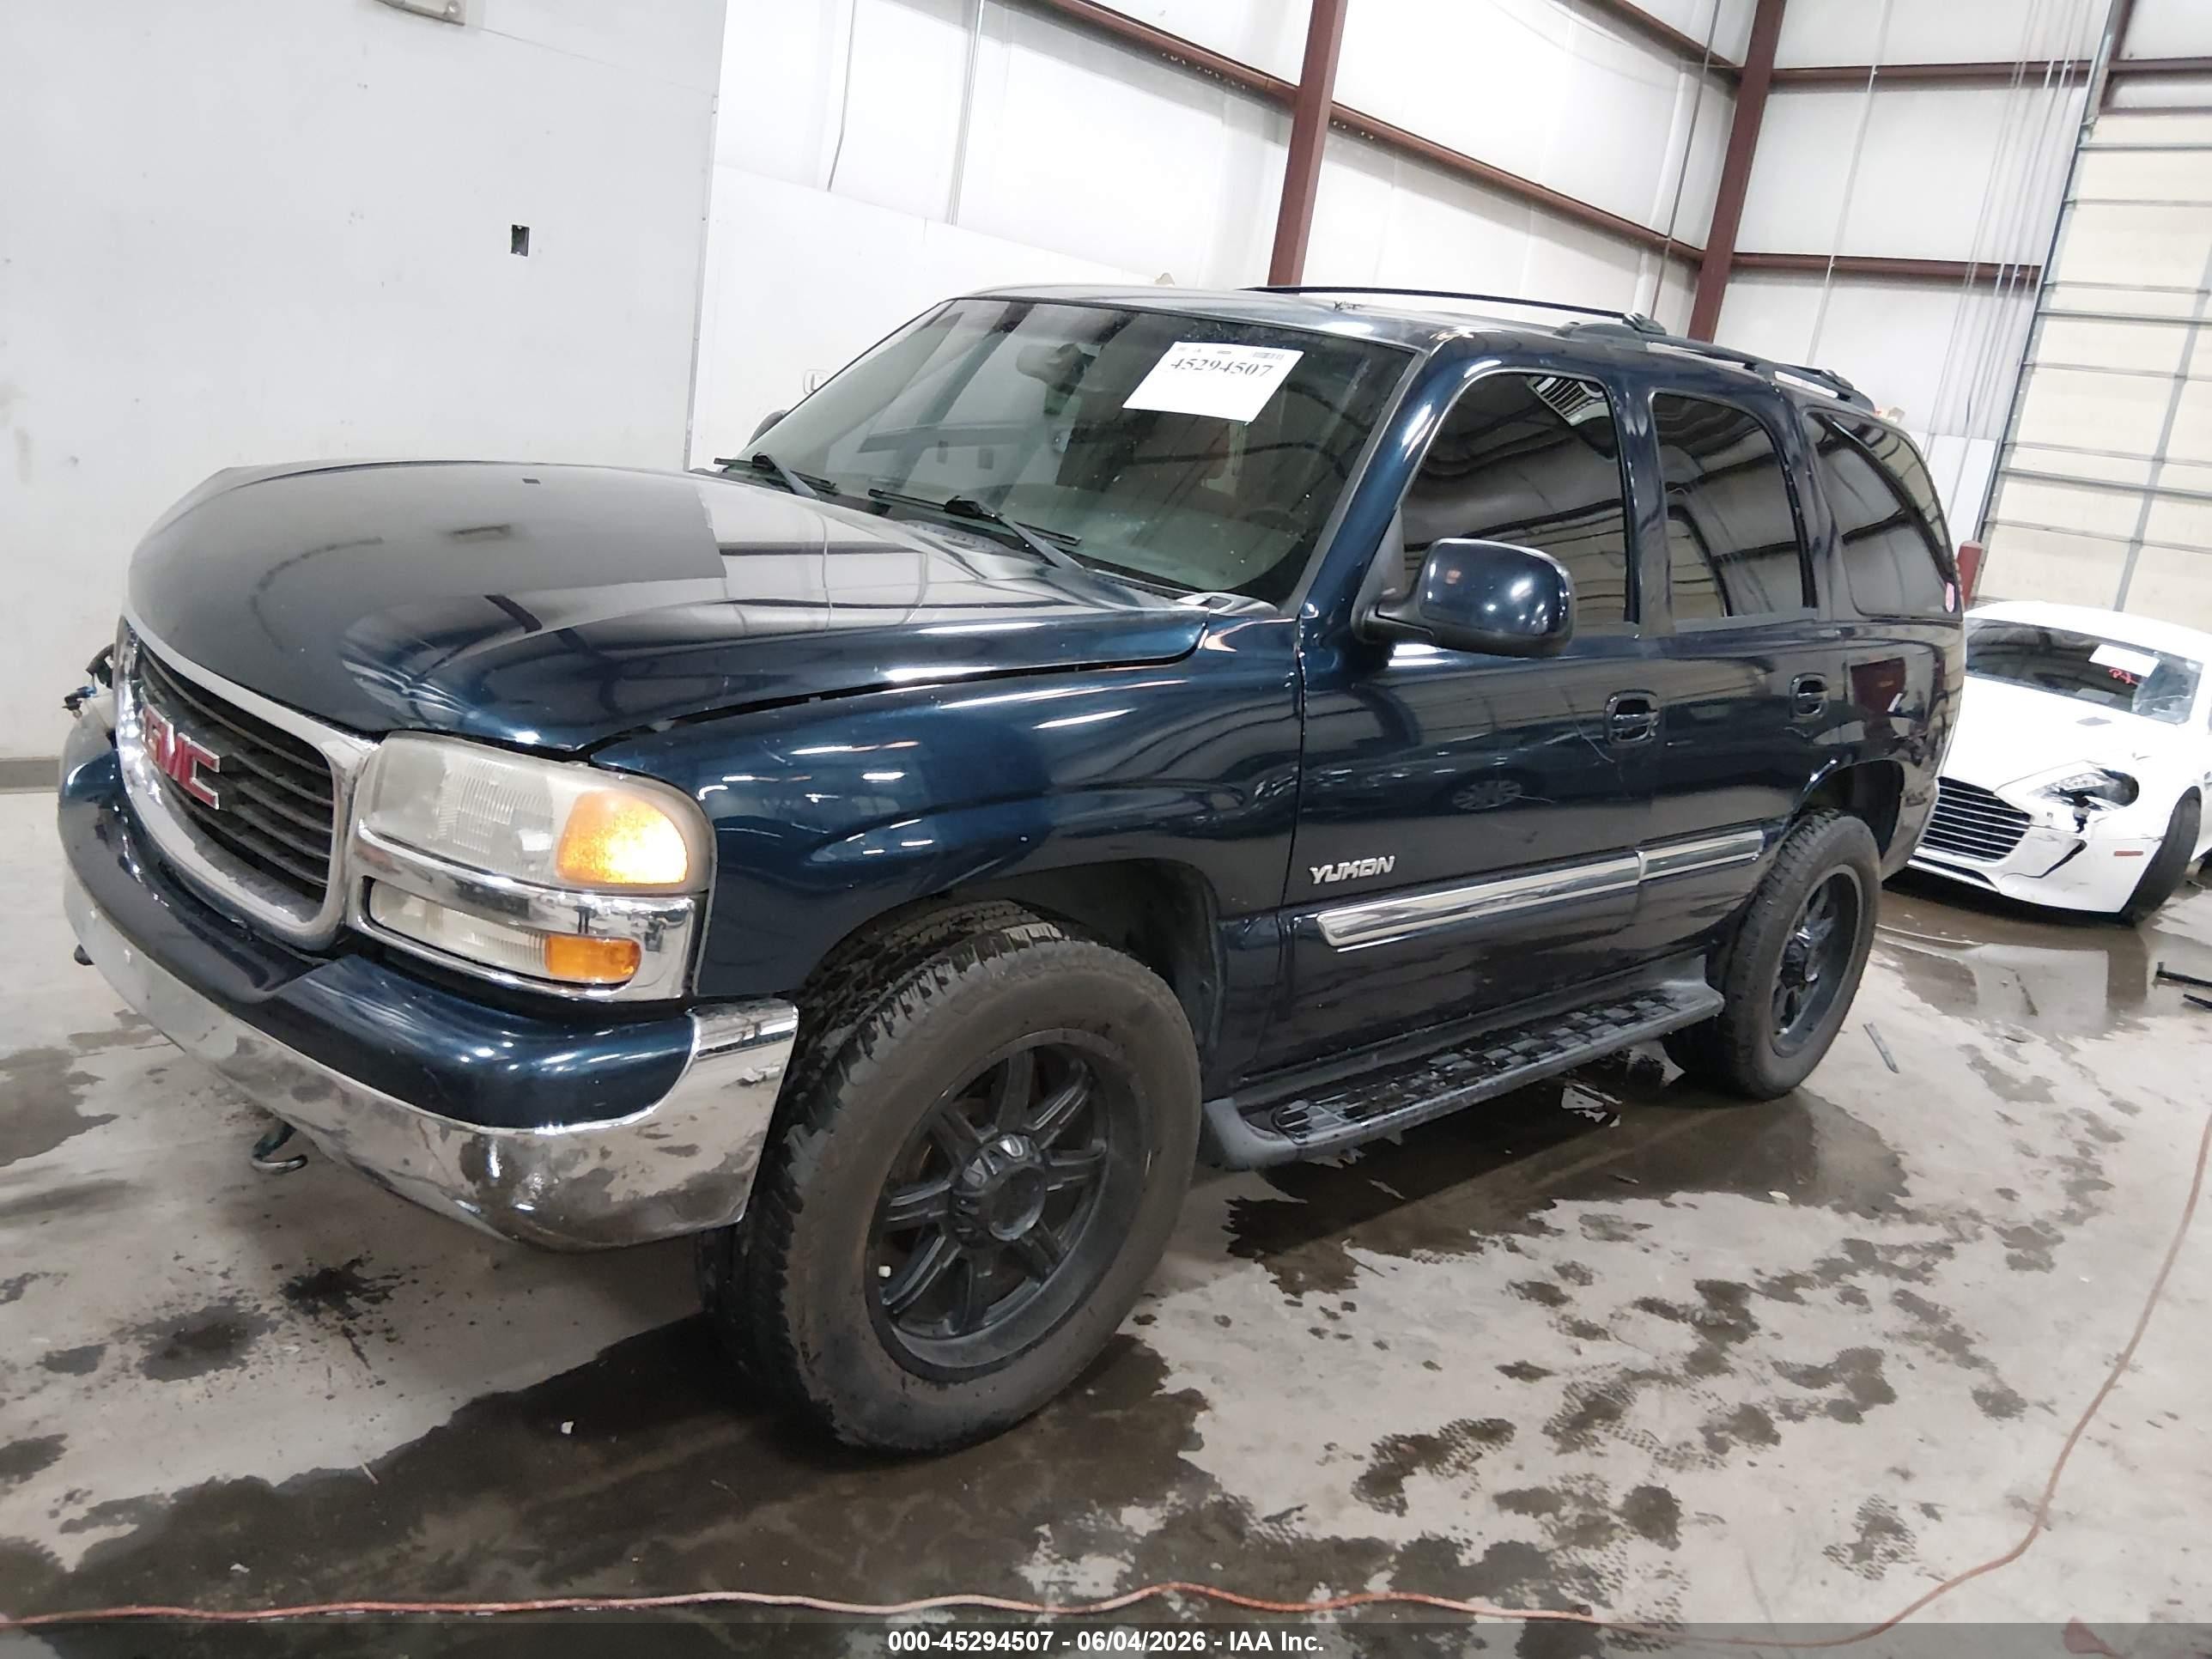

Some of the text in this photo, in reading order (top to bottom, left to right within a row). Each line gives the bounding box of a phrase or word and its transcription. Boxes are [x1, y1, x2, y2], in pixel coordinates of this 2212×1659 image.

[1170, 357, 1274, 378] 45294507
[143, 703, 221, 811] GMC
[1309, 855, 1395, 884] YUKON
